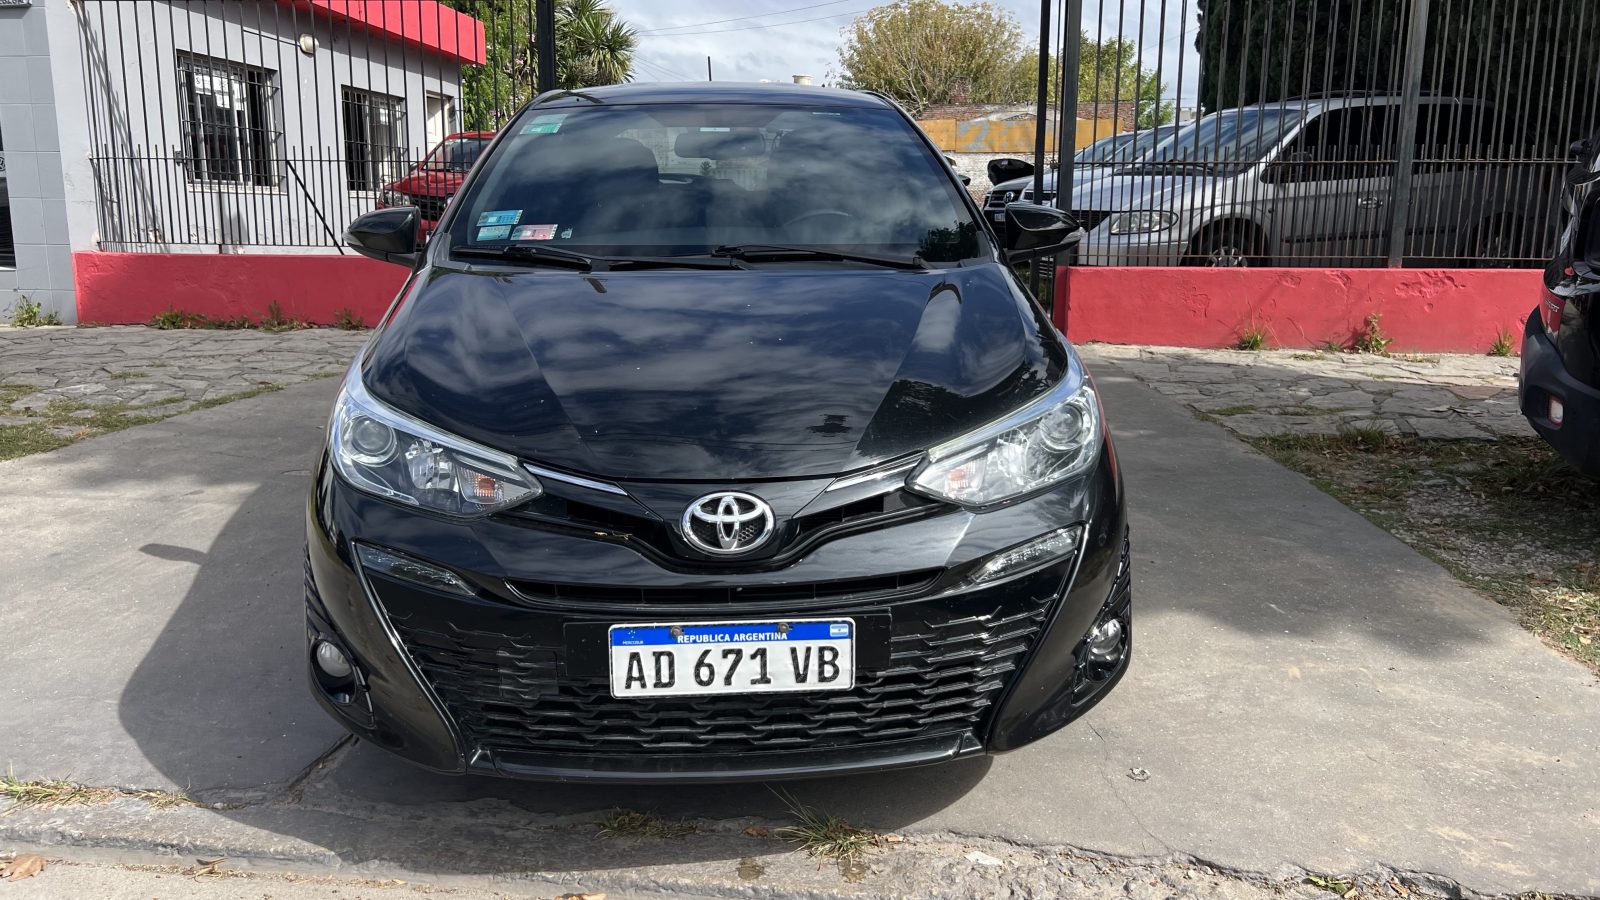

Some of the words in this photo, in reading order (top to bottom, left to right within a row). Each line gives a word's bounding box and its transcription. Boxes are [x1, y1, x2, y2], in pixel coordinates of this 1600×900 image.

[677, 633, 730, 644] REPUBLICA
[733, 632, 788, 642] ARGENTINA
[624, 651, 676, 690] AD
[693, 648, 772, 687] 671
[789, 646, 841, 684] VB
